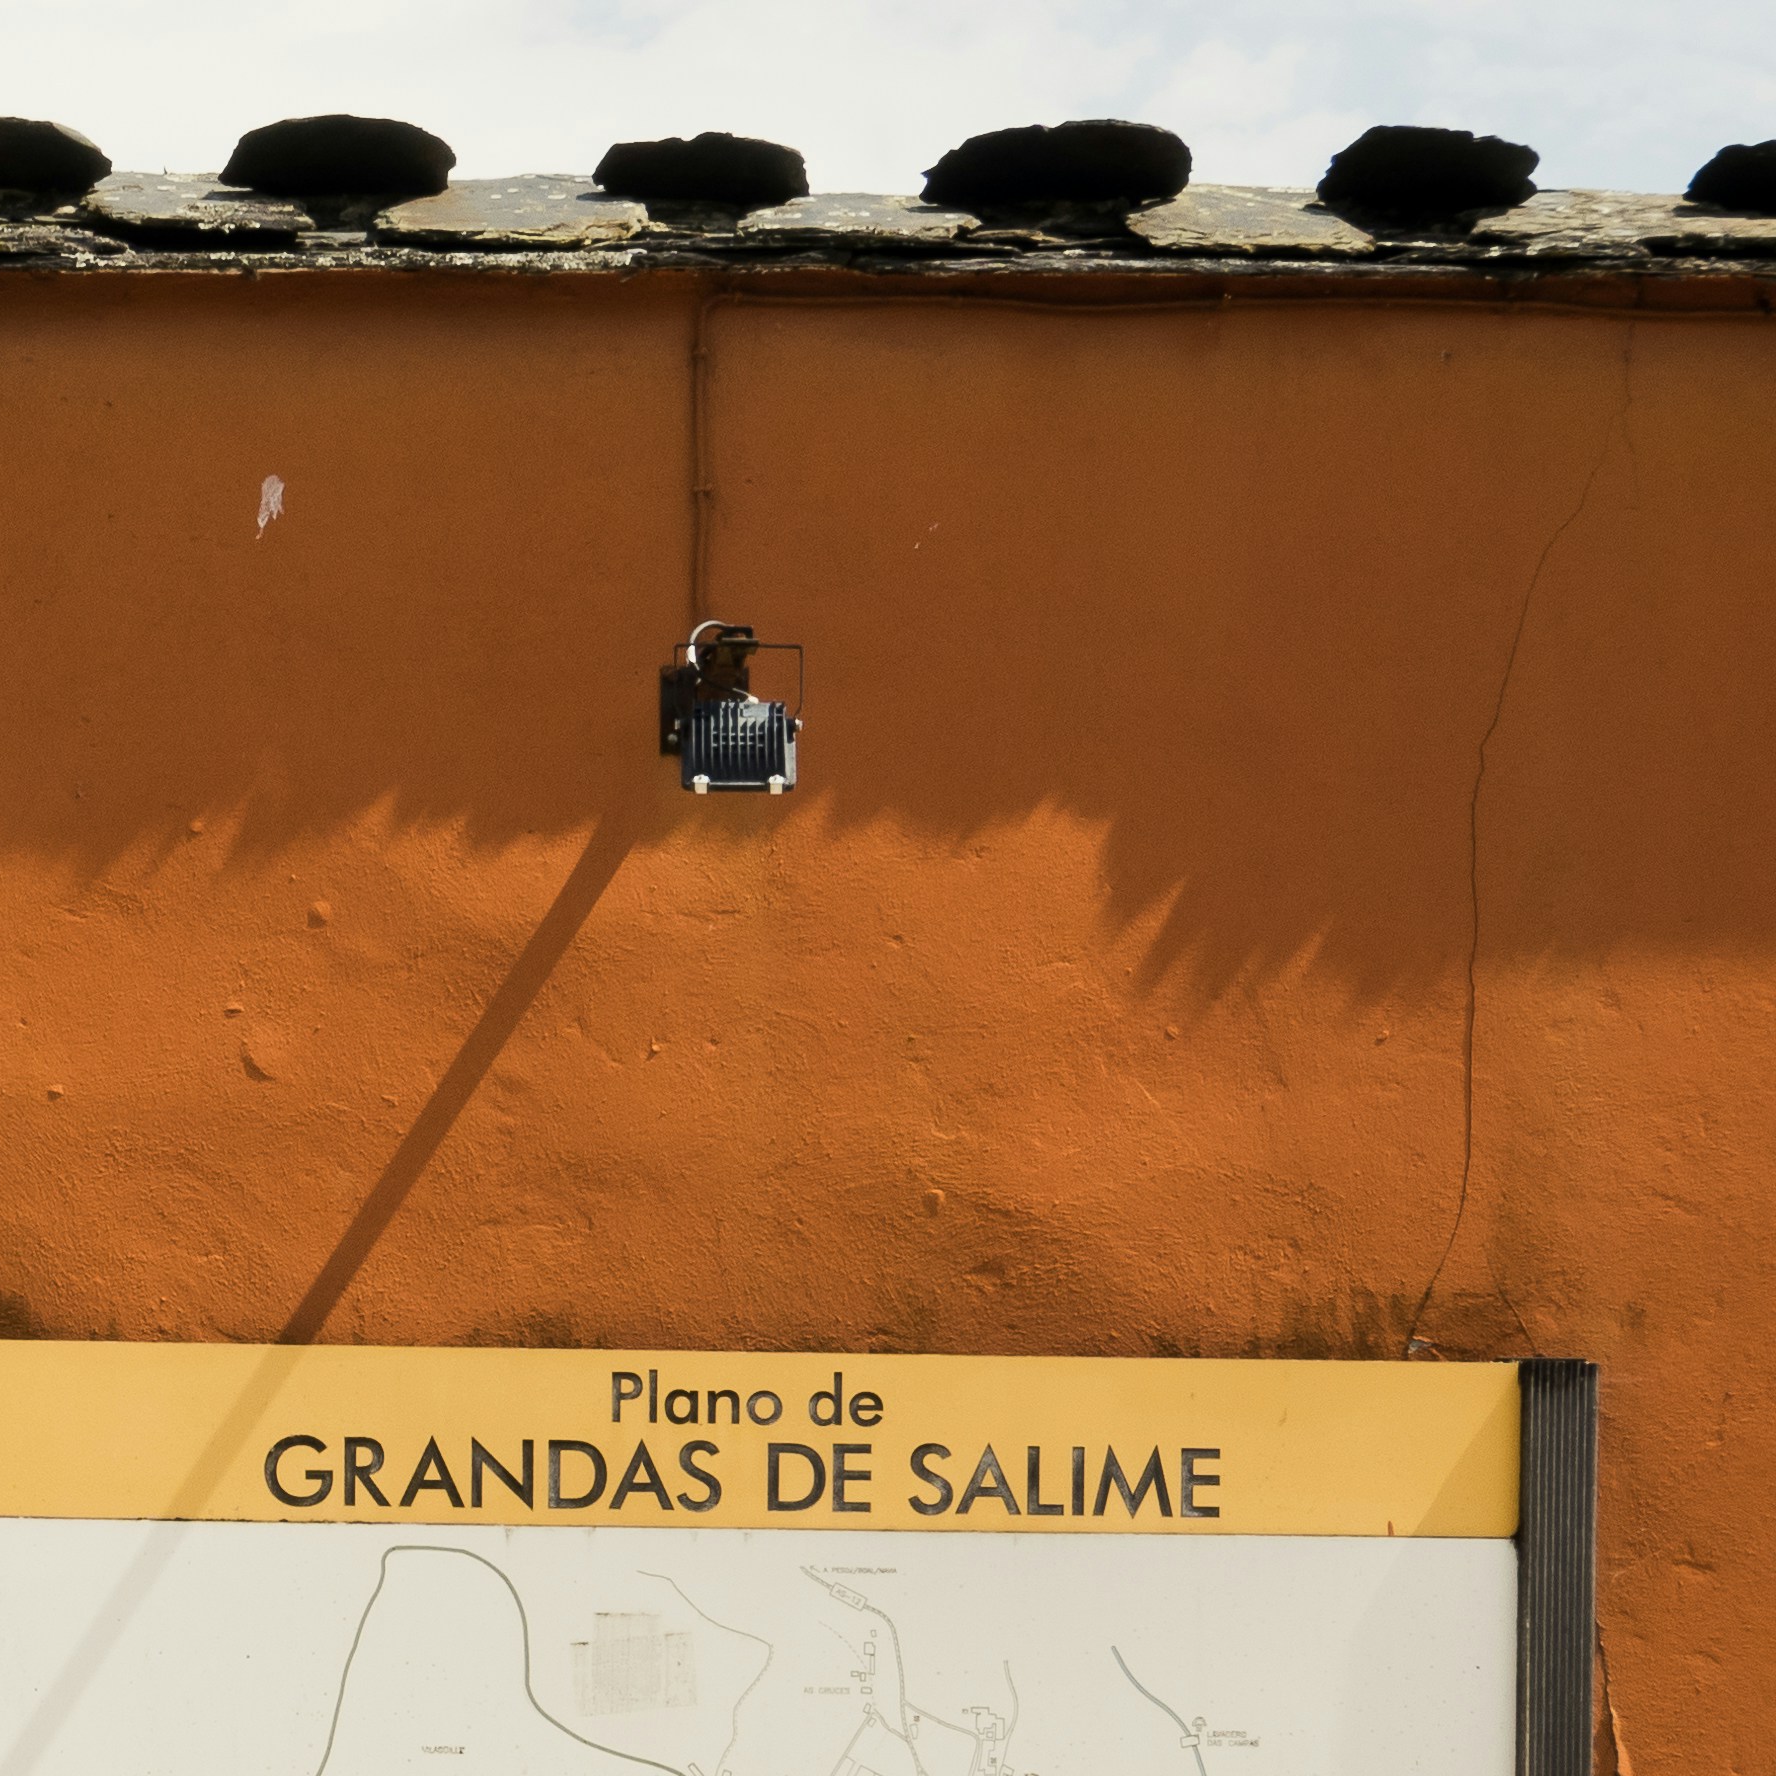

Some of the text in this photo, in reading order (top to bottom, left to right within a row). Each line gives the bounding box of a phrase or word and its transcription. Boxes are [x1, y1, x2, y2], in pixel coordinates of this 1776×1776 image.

[611, 1370, 884, 1428] Plano de
[263, 1434, 1221, 1519] GRANDAS DE SALIME
